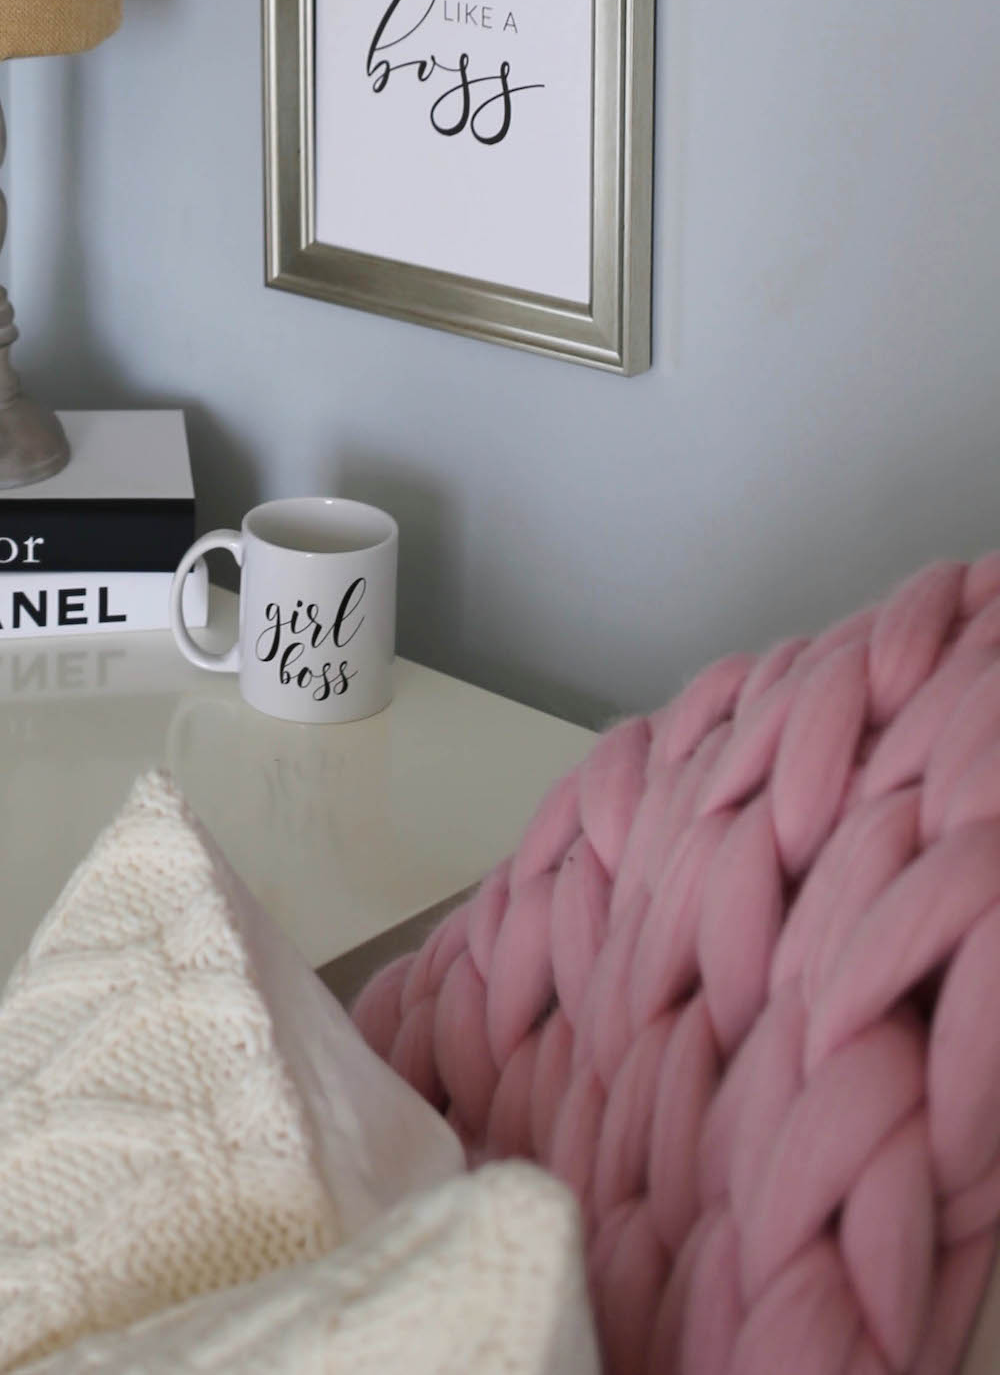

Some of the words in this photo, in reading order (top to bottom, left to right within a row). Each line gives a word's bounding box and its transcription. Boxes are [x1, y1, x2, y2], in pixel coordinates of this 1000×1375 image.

[502, 11, 519, 34] A
[255, 576, 367, 662] girl
[280, 642, 359, 701] boss
